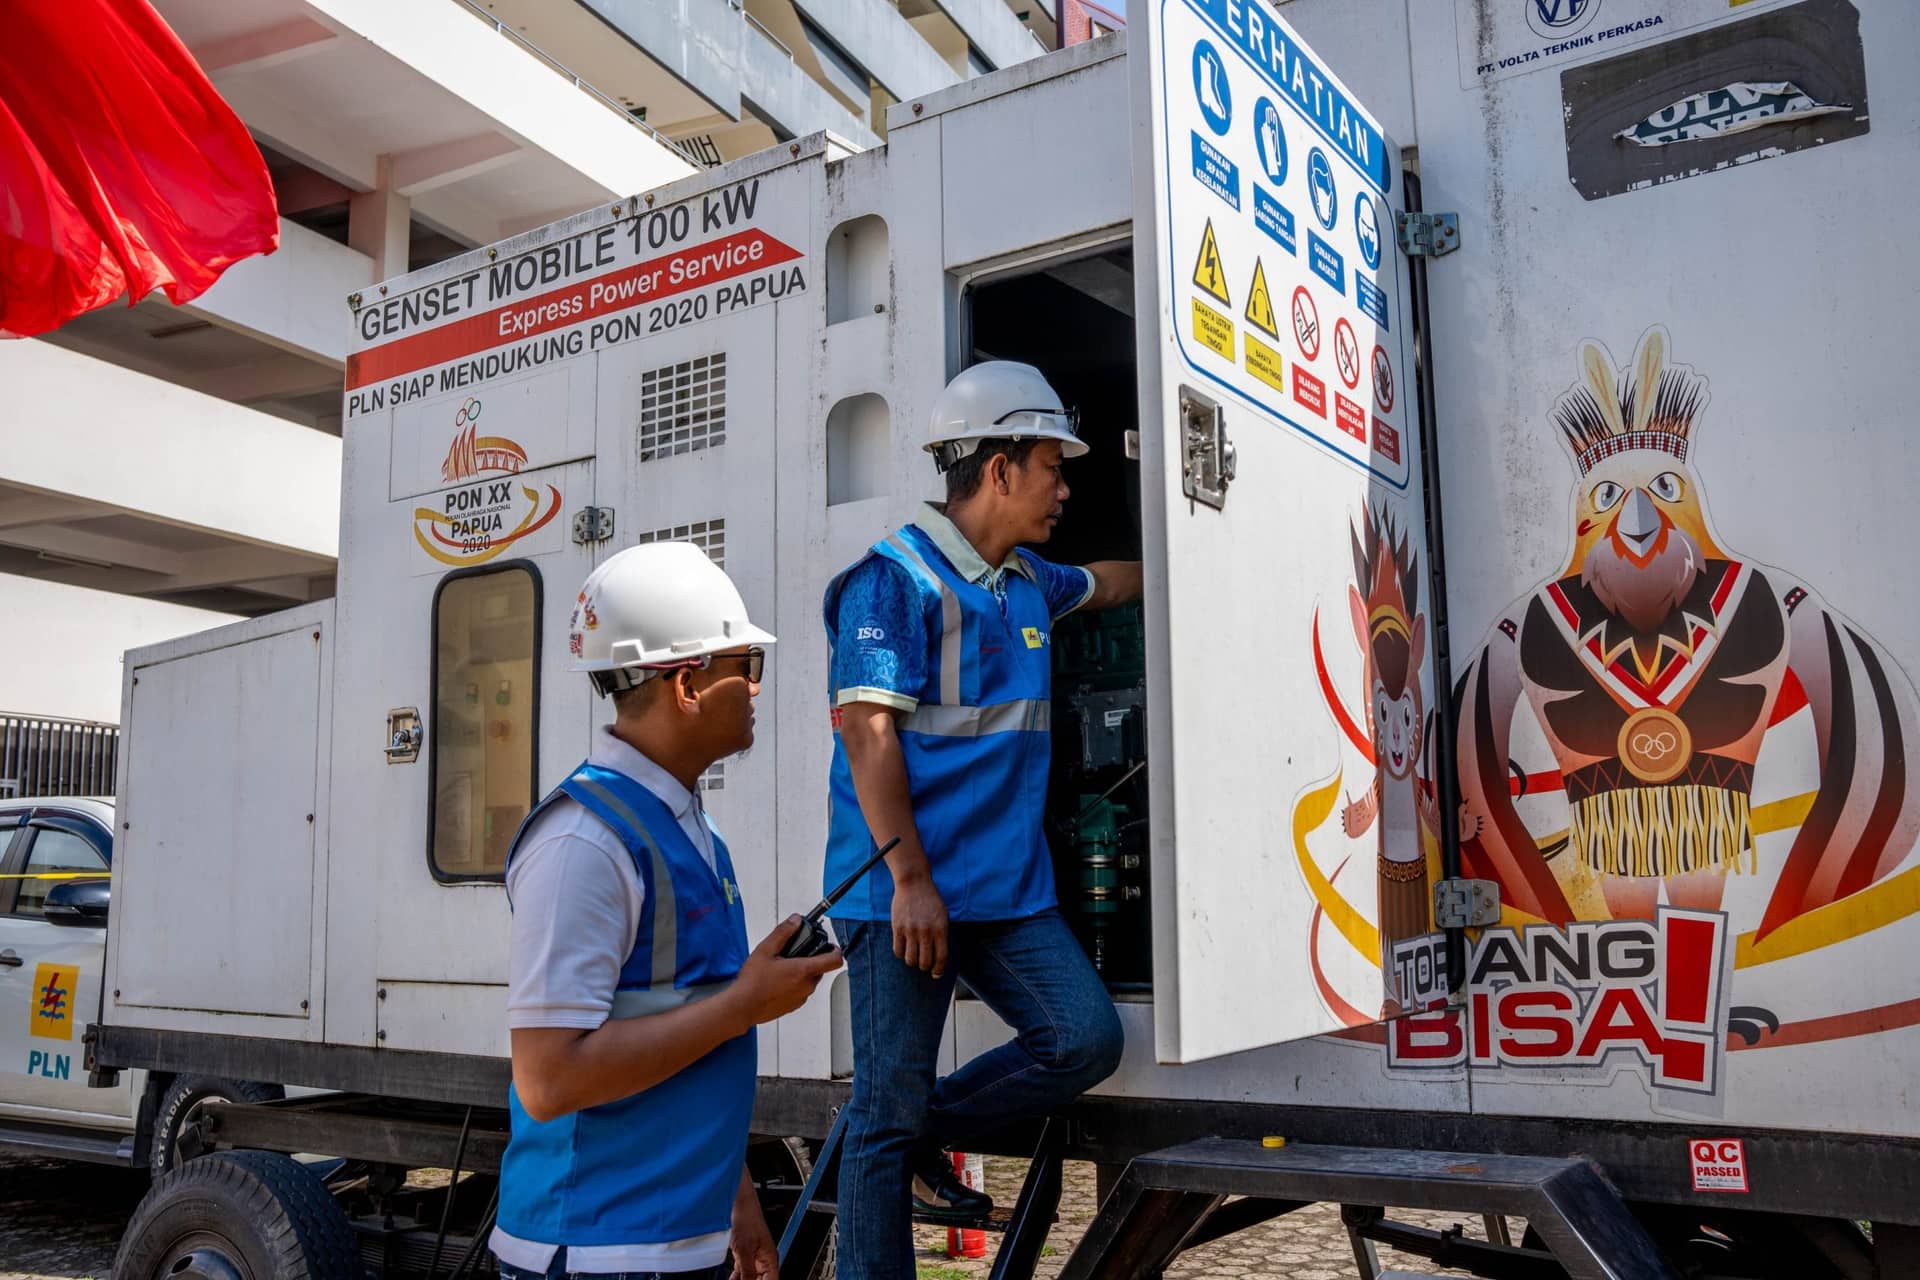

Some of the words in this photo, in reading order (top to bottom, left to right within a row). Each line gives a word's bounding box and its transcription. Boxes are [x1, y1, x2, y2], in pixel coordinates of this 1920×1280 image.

[1477, 64, 1495, 75] PT.
[1498, 50, 1540, 69] VOLTA
[1543, 34, 1594, 56] TEKNIK
[1597, 15, 1664, 41] PERKASA
[1204, 0, 1370, 166] ERHATIAN
[361, 274, 481, 341] GENSET
[488, 229, 616, 302] MOBILE
[627, 204, 690, 256] 100
[702, 179, 760, 234] kW
[498, 294, 583, 338] Express
[590, 270, 662, 308] Power
[669, 239, 764, 286] Service
[348, 383, 385, 418] PLN
[389, 373, 435, 407] SIAP
[440, 330, 583, 393] MENDUKUNG
[590, 312, 642, 350] PON
[648, 295, 708, 333] 2020
[716, 266, 807, 314] PAPUA
[446, 487, 482, 514] PON
[488, 481, 512, 505] XX
[451, 513, 503, 539] PAPUA
[462, 534, 491, 554] 2020
[857, 627, 885, 641] ISO
[27, 1050, 71, 1081] PLN
[160, 1087, 193, 1139] RADIAL
[1693, 1142, 1739, 1164] QC
[1696, 1166, 1741, 1177] PASSED
